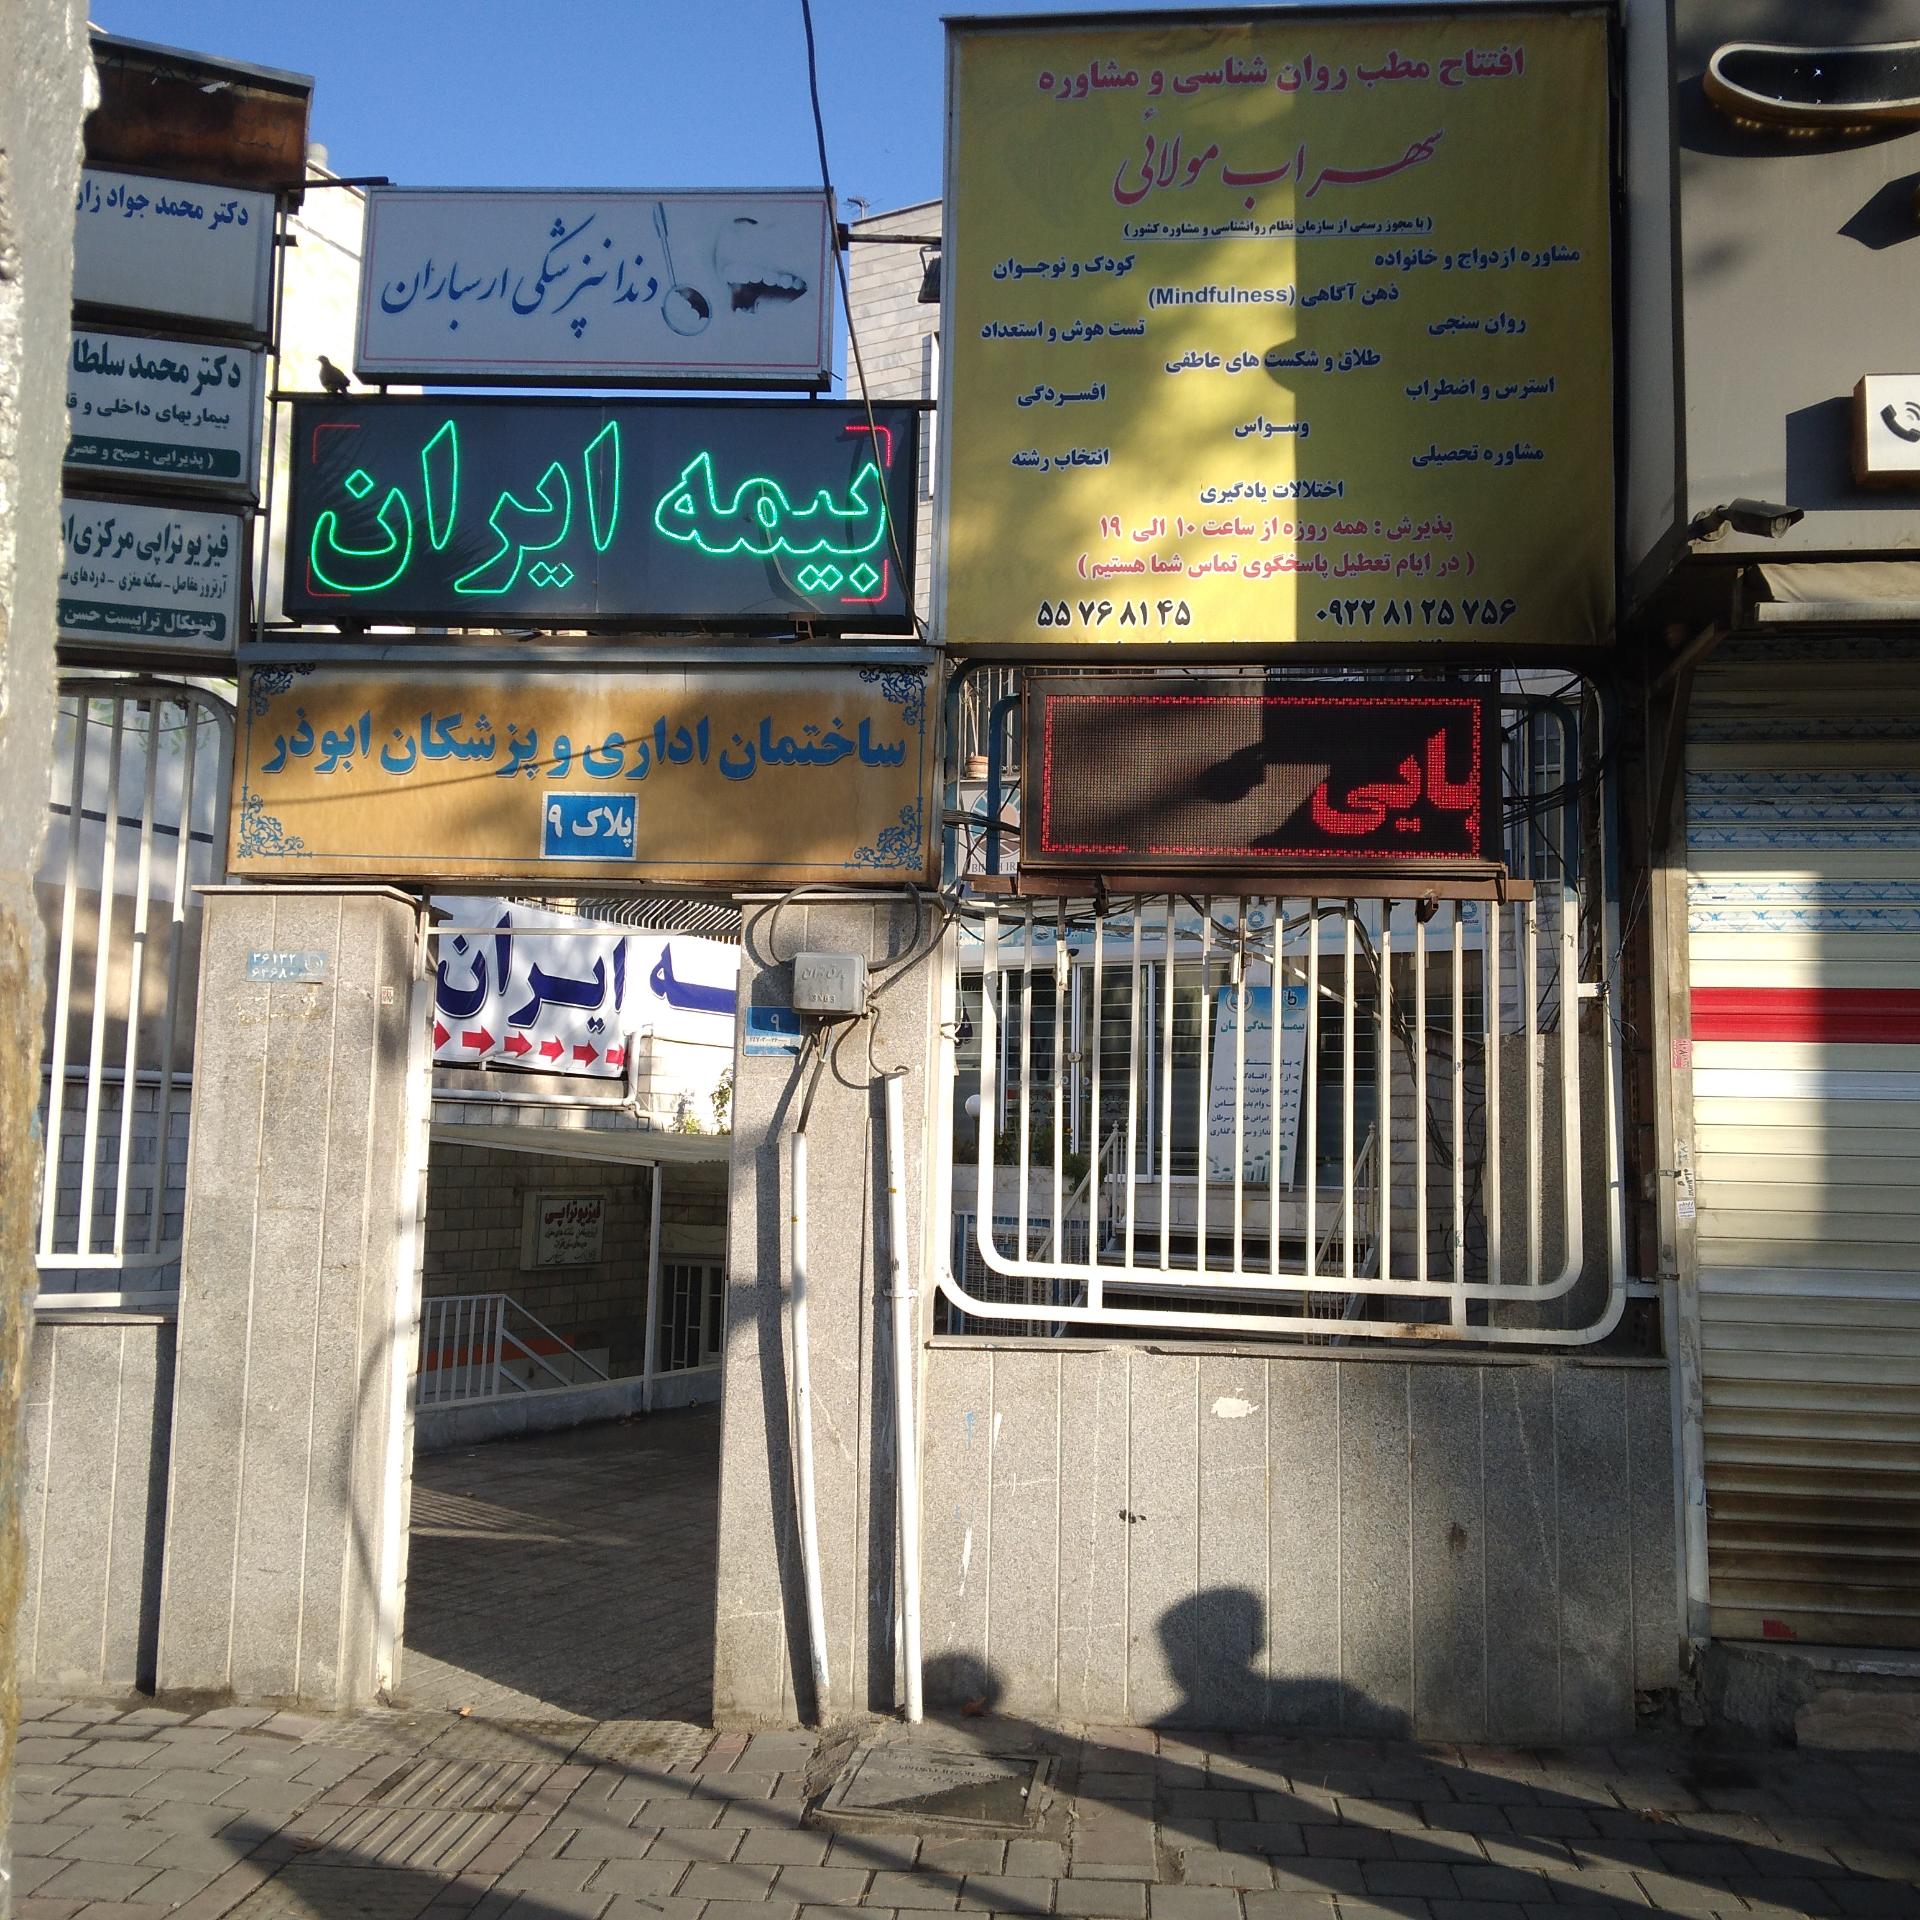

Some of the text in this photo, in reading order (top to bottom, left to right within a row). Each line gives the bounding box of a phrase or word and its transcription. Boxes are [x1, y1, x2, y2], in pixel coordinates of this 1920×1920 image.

[1038, 47, 1525, 99] افتتاح مطب روان شناسی و مشاوره
[1222, 128, 1446, 211] سهراب
[106, 185, 150, 220] جواد
[155, 196, 203, 221] محمد
[208, 200, 249, 230] دکتر
[1163, 222, 1200, 238] مشاوره
[1211, 220, 1266, 236] روانشناسی
[1269, 220, 1294, 235] نظام
[1295, 219, 1334, 234] سازمان
[1337, 219, 1348, 233] از
[1350, 220, 1382, 233] رسمی
[1385, 219, 1413, 233] مجوز
[1071, 262, 1080, 277] و
[1085, 254, 1135, 276] کودک
[1374, 244, 1581, 271] مشاوره ازدواج و خانواده
[380, 258, 509, 331] ارسباران
[1148, 281, 1400, 310] ذهن آگاهی (Mindfulness)
[981, 318, 1146, 342] تست هوش و استعداد
[1428, 311, 1527, 336] روان سنجی
[128, 353, 190, 384] محمد
[1164, 348, 1381, 374] طلاق و شکست های عاطفی
[190, 354, 241, 396] دکتر
[1405, 376, 1556, 402] استرس و اضطراب
[83, 401, 92, 415] و
[97, 399, 150, 417] داخلی
[101, 448, 108, 460] و
[112, 447, 140, 463] صبح
[1011, 448, 1110, 473] انتخاب رشته
[1411, 442, 1544, 468] مشاوره تحصیلی
[1200, 480, 1344, 503] اختلالات یادگیری
[310, 420, 887, 594] بیمه ایران
[73, 517, 134, 559] مرکزی
[1100, 515, 1121, 538] ۱۹
[1133, 517, 1166, 542] الی
[1177, 516, 1196, 538] ۱۰
[1202, 516, 1255, 537] ساعت
[1260, 516, 1278, 542] از
[1283, 520, 1328, 542] روزه
[1332, 519, 1369, 536] همه
[136, 523, 229, 568] فیزیوتراپی
[1151, 553, 1183, 573] شما
[1187, 553, 1238, 578] تماس
[1242, 552, 1328, 579] پاسخگوی
[1333, 552, 1391, 578] تعطیل
[1396, 552, 1431, 578] ایام
[172, 575, 198, 595] مفاصل
[199, 574, 228, 599] آرتروز
[63, 607, 101, 623] حسن
[104, 609, 161, 632] تراپیست
[261, 704, 908, 783] ساختمان اداری و پزشکان ابوذر
[546, 800, 634, 849] پلاک ۹
[435, 911, 626, 1034] ایران
[770, 1013, 780, 1033] ۹
